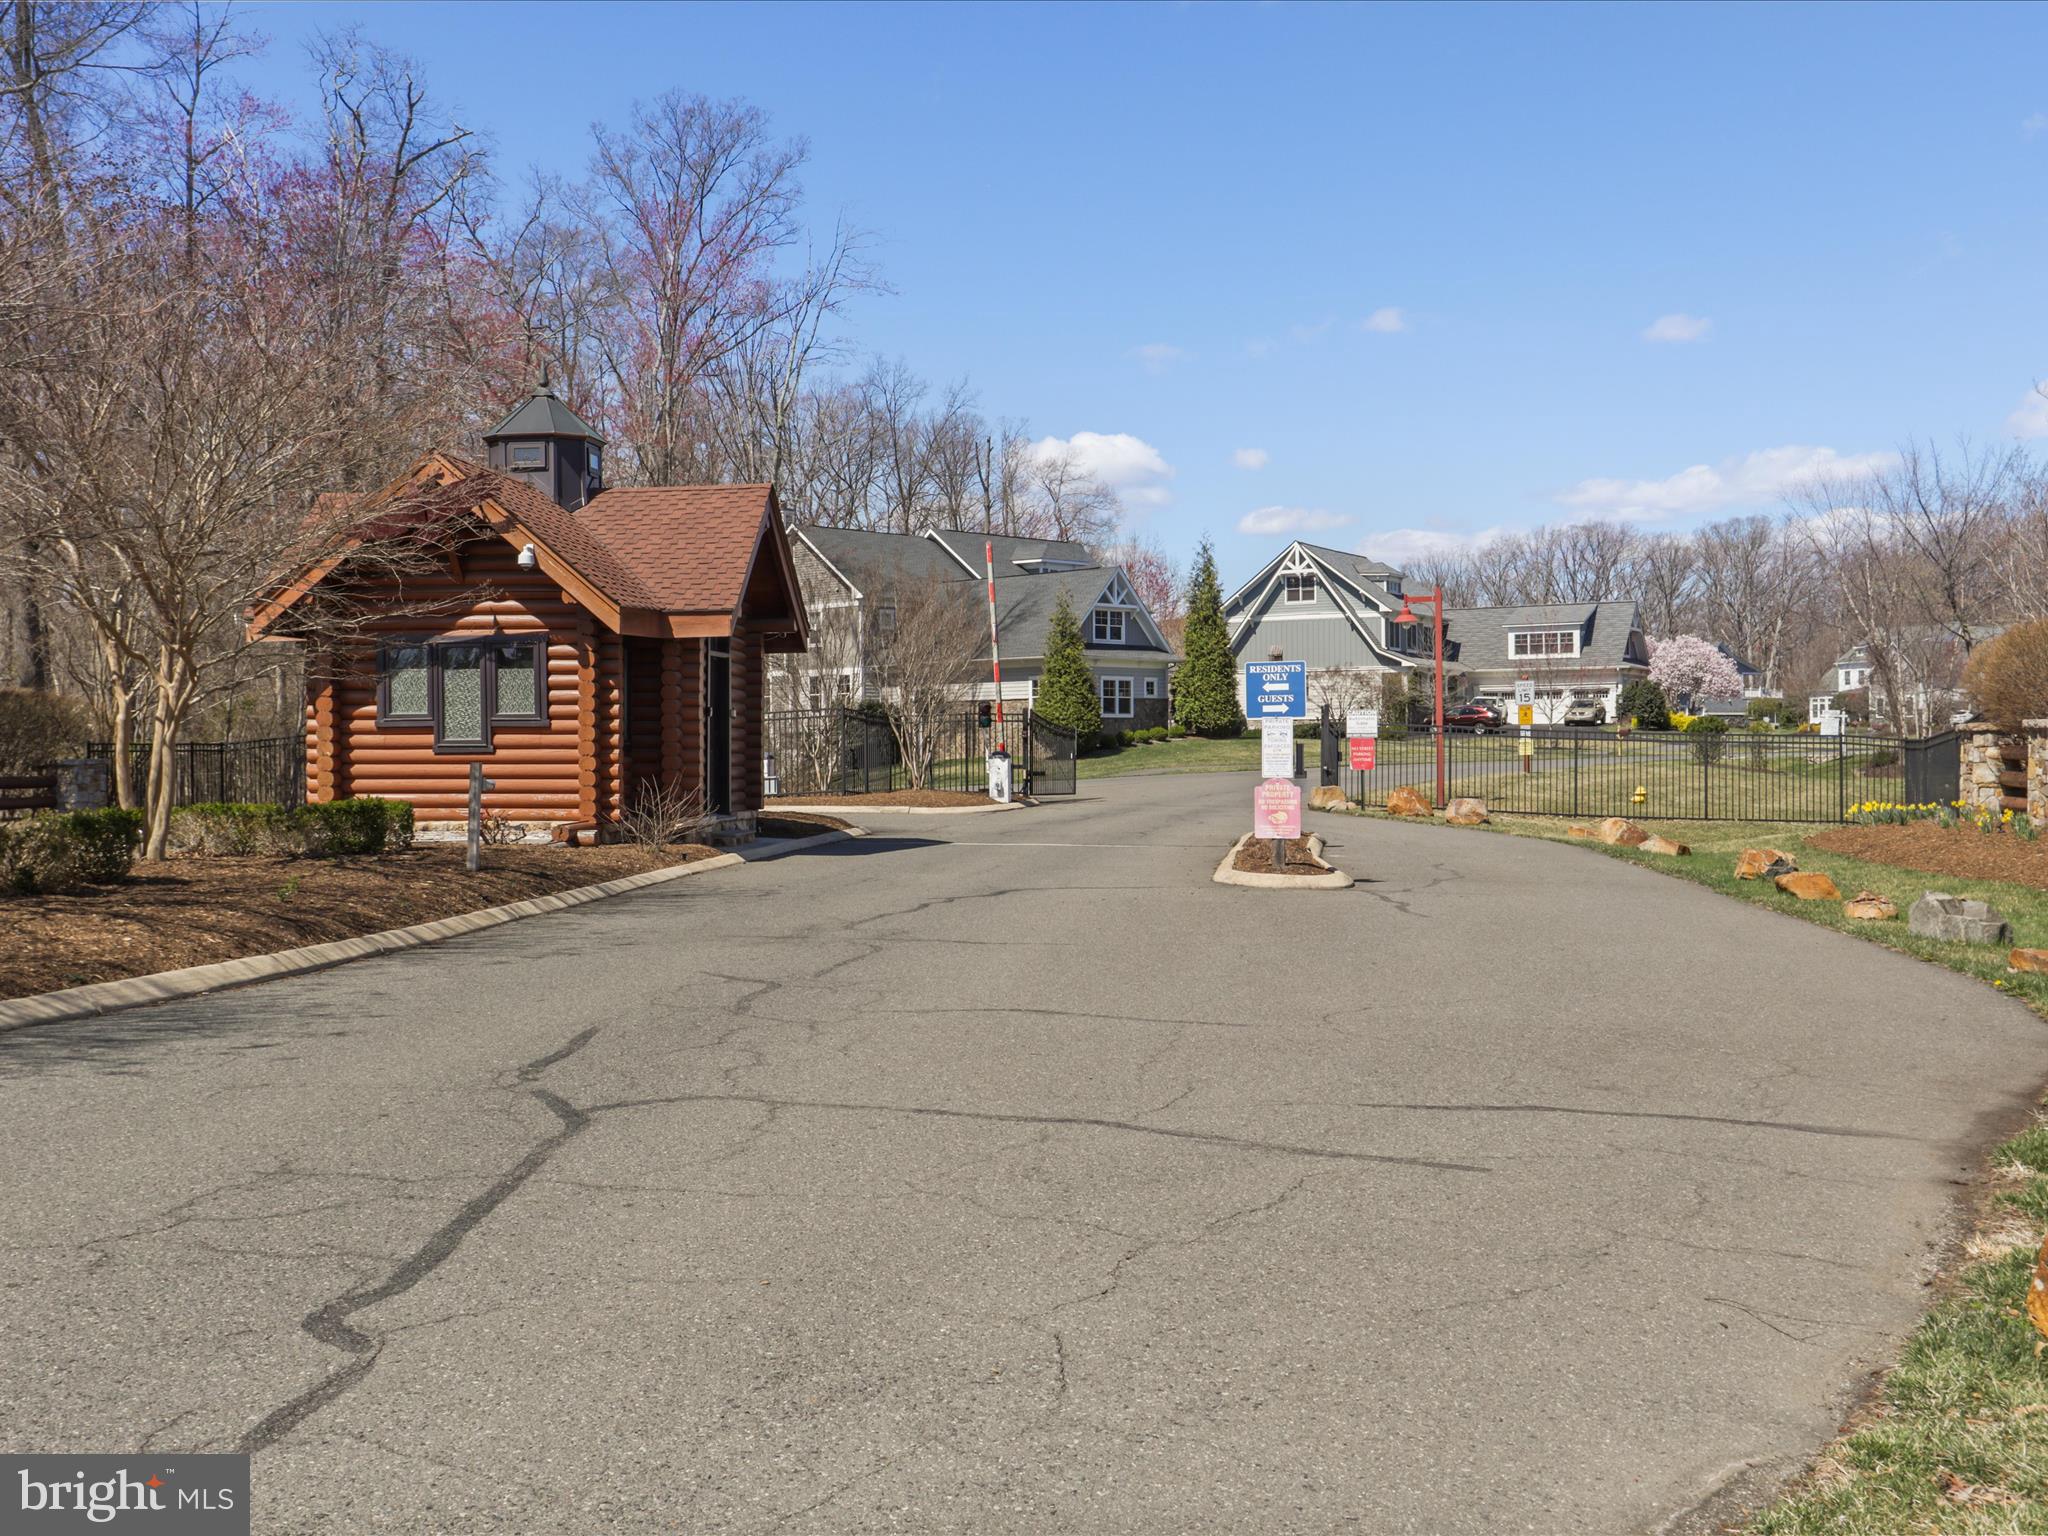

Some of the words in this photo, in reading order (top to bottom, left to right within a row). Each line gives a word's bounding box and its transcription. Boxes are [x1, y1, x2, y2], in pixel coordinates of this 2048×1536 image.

[1249, 665, 1301, 673] RESIDENTS
[1263, 673, 1288, 681] ONLY
[1258, 695, 1294, 703] GUESTS
[1519, 693, 1531, 702] 15
